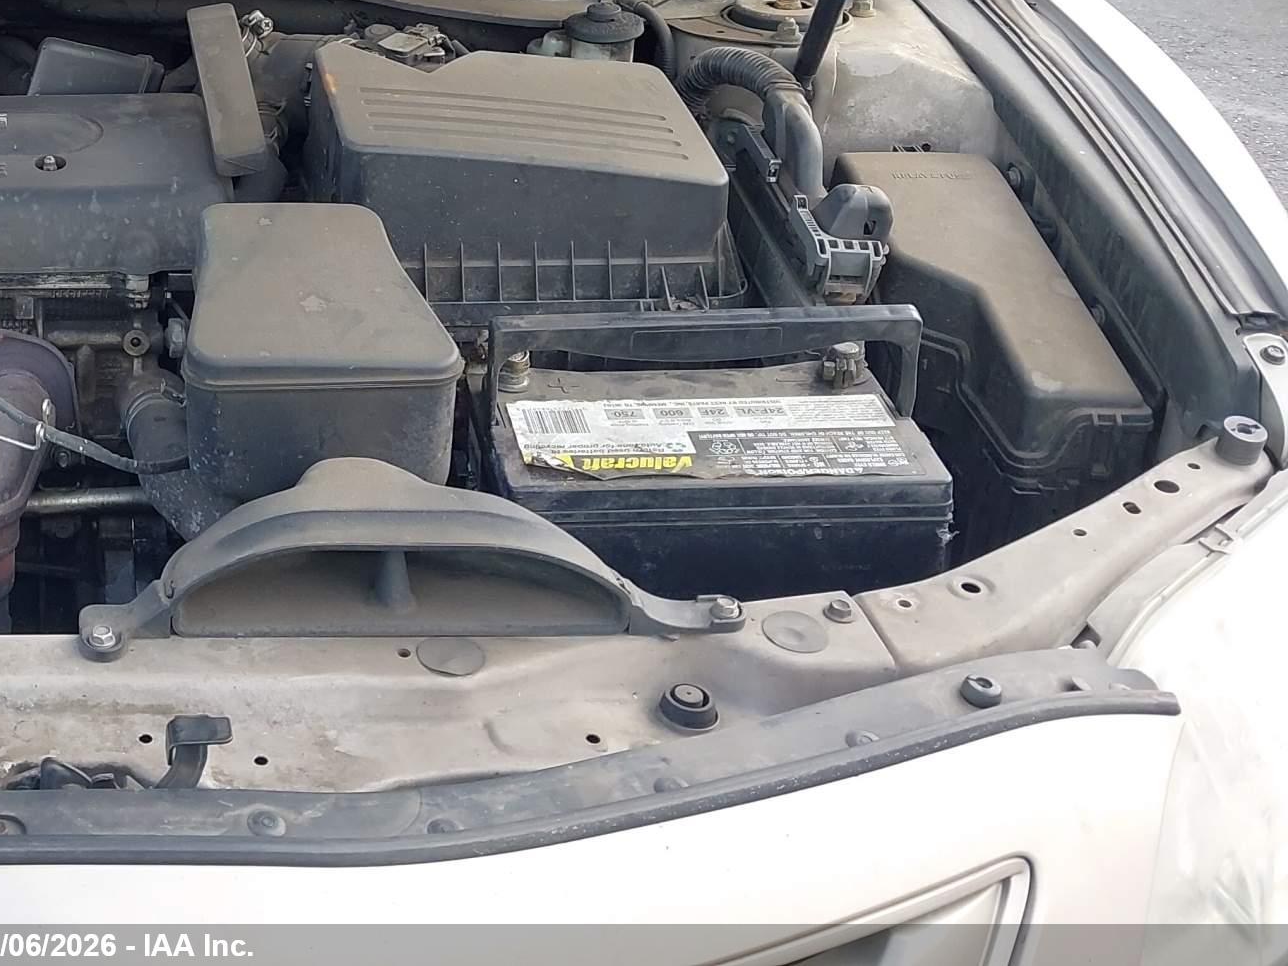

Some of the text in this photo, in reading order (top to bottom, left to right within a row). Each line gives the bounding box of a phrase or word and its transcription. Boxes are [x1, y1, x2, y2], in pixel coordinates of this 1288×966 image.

[614, 410, 636, 418] 750
[700, 408, 725, 416] 24F
[580, 456, 692, 472] Valucraft
